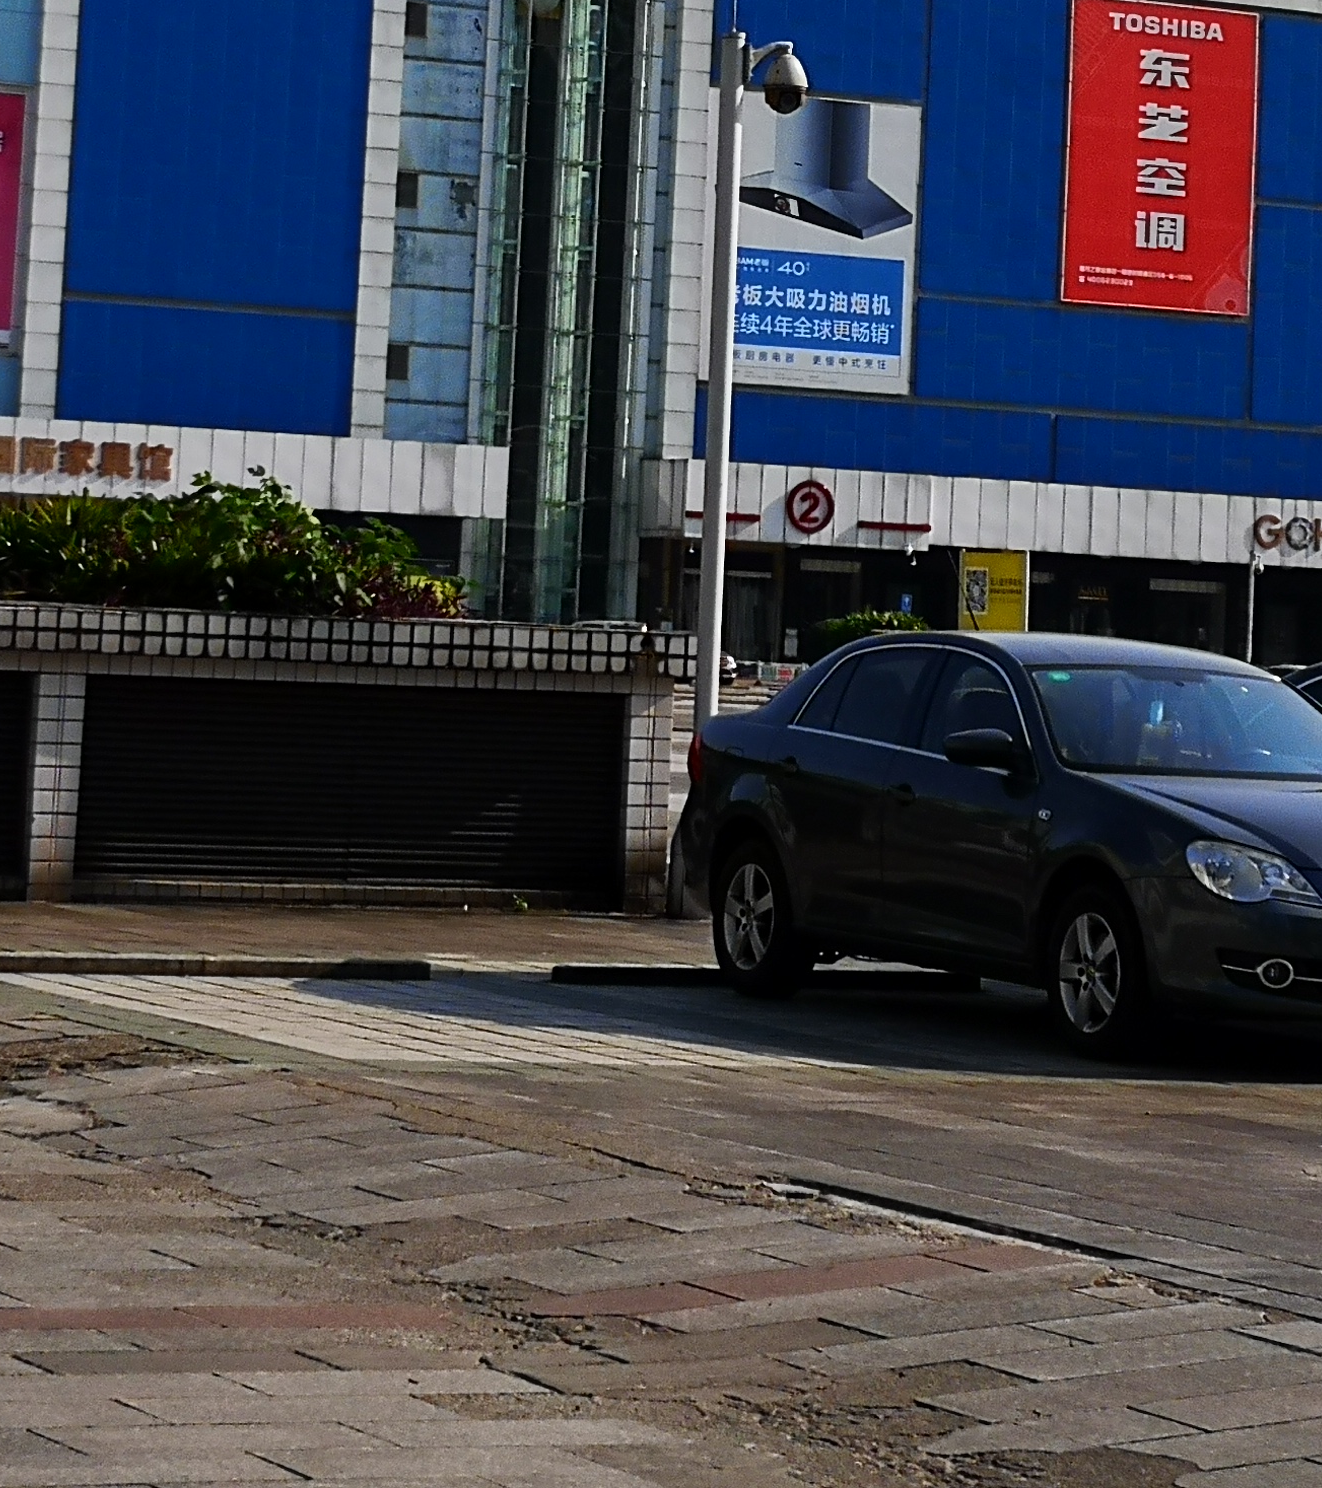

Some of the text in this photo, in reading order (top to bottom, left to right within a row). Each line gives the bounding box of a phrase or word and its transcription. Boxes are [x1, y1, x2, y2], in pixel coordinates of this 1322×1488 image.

[1108, 11, 1224, 41] TOSHIBA
[1134, 48, 1191, 252] 东芝空调
